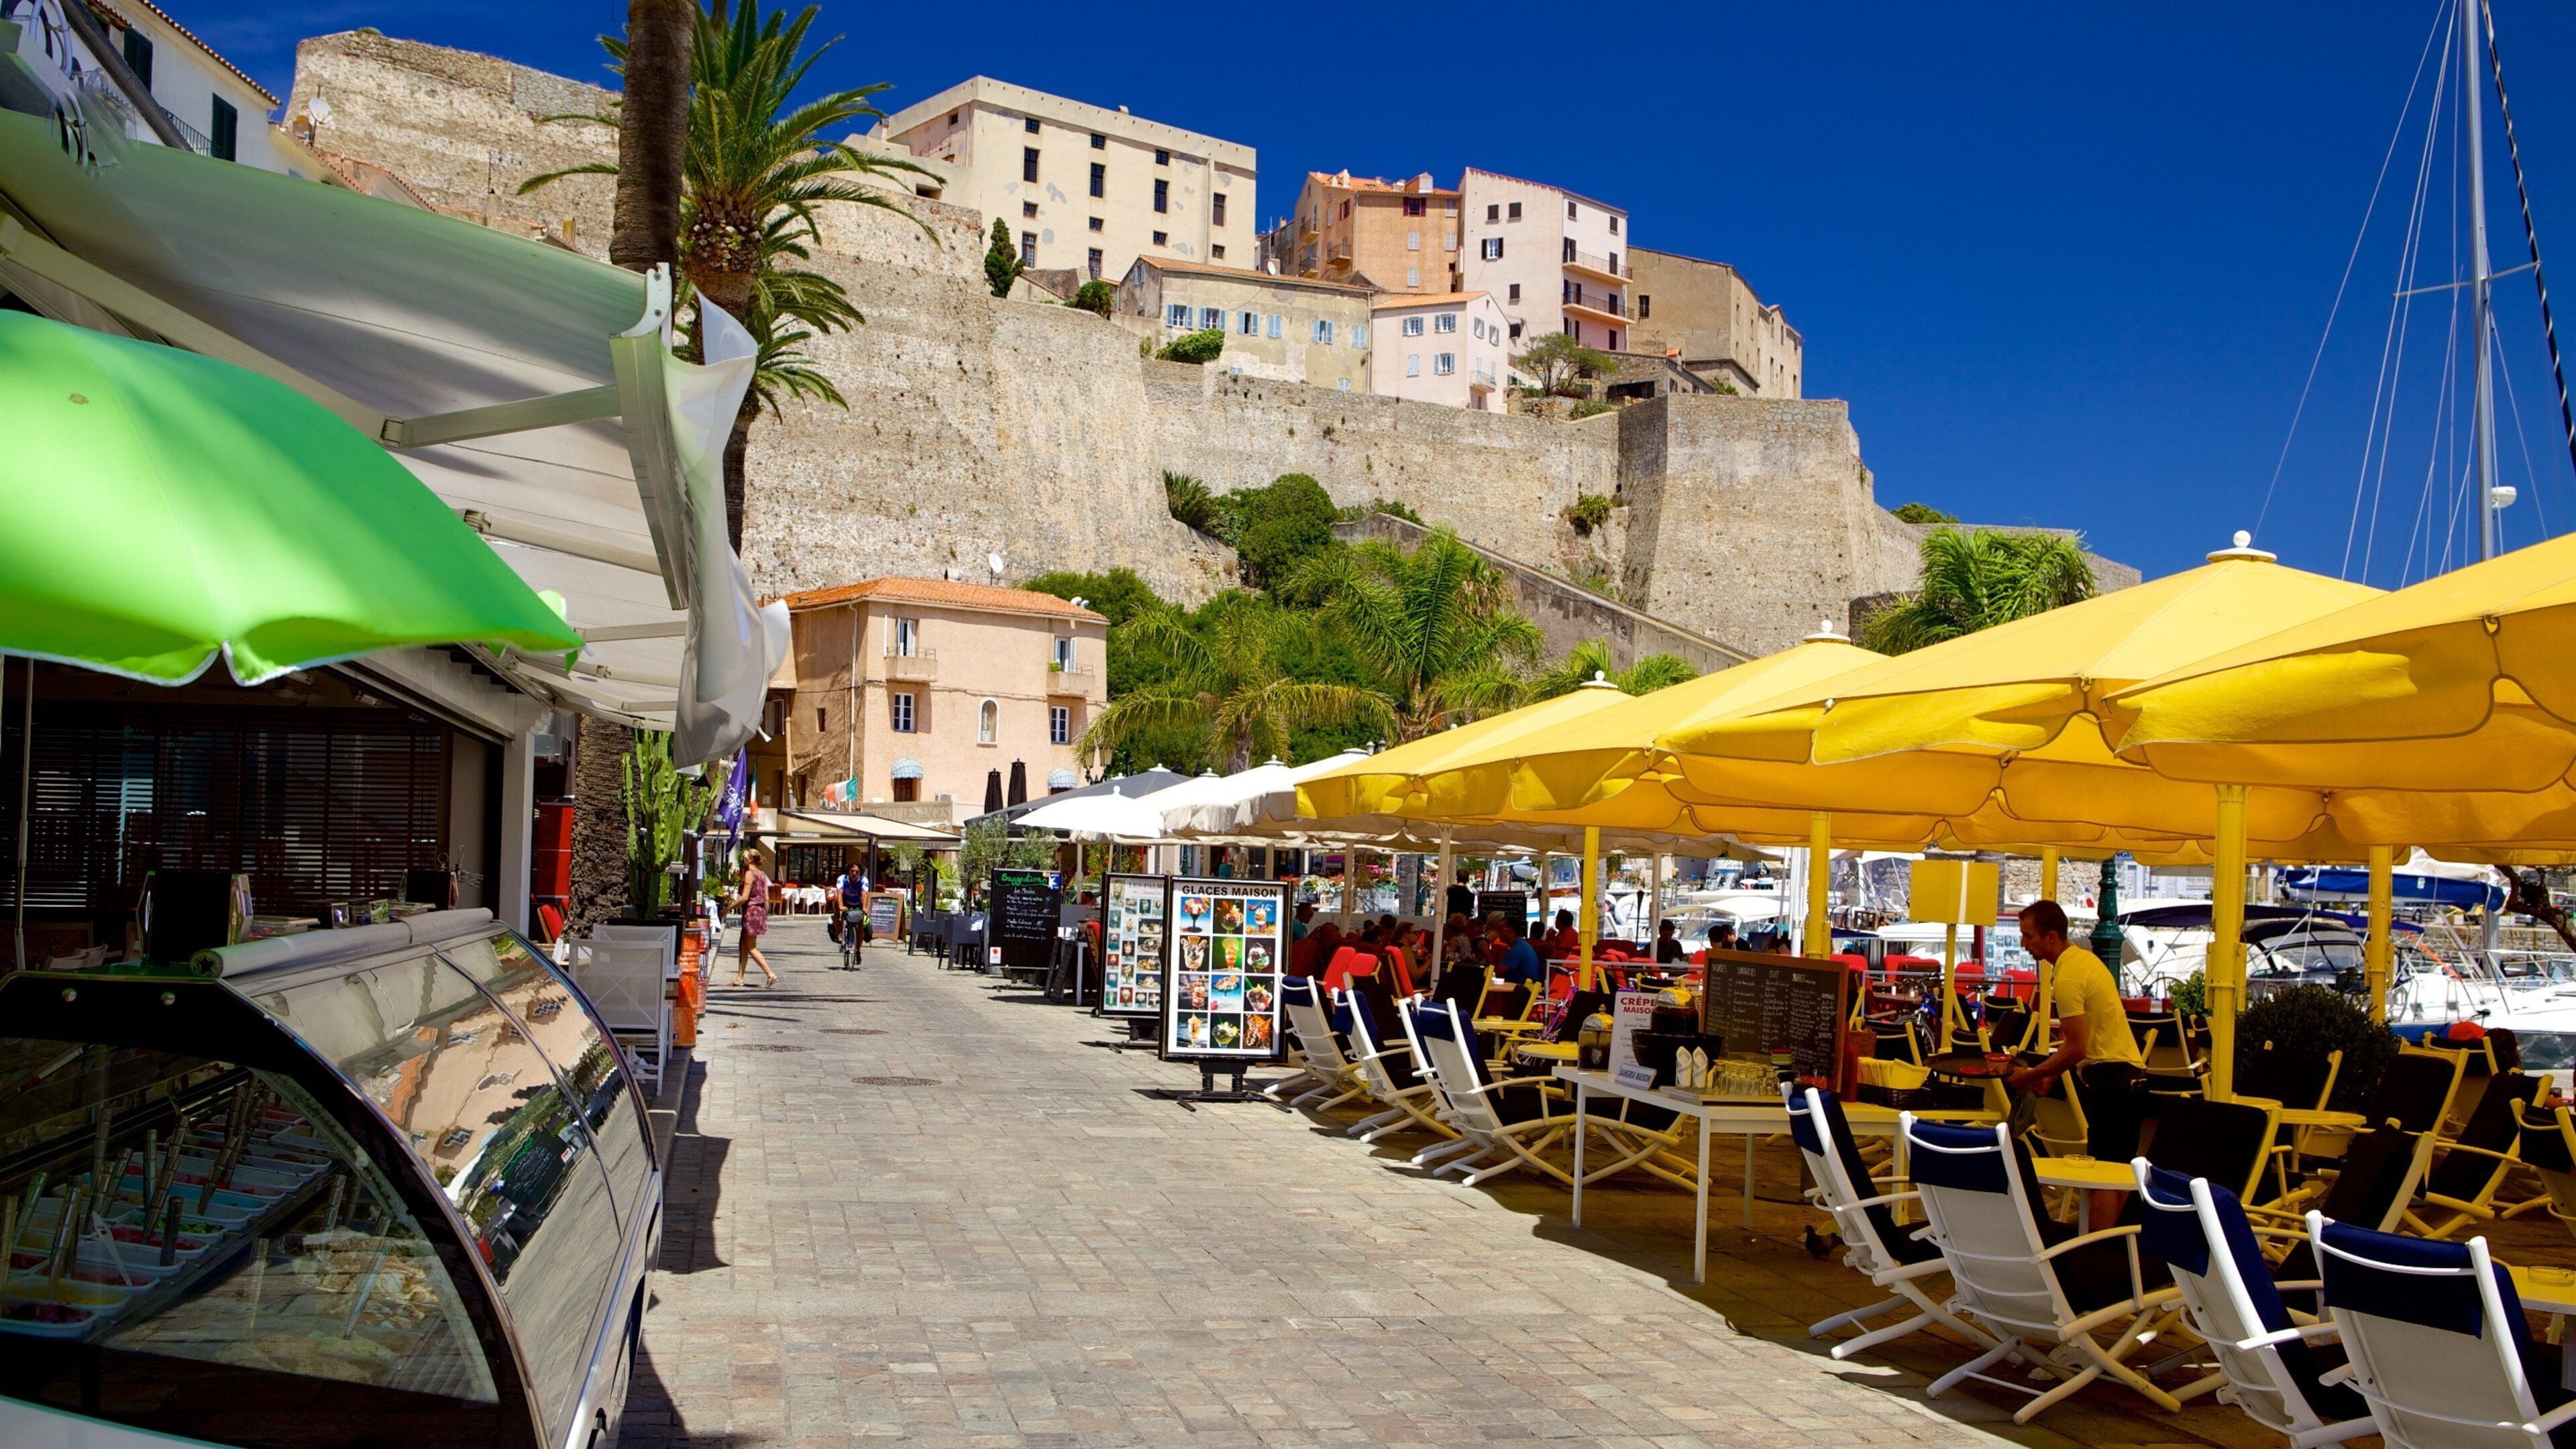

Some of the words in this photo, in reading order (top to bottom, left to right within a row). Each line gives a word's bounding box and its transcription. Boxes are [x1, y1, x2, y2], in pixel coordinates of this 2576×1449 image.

[1002, 873, 1047, 885] Suggestions
[1182, 885, 1228, 896] GLACES
[1232, 887, 1277, 898] MAISON
[1621, 996, 1657, 1006] CRÊPE
